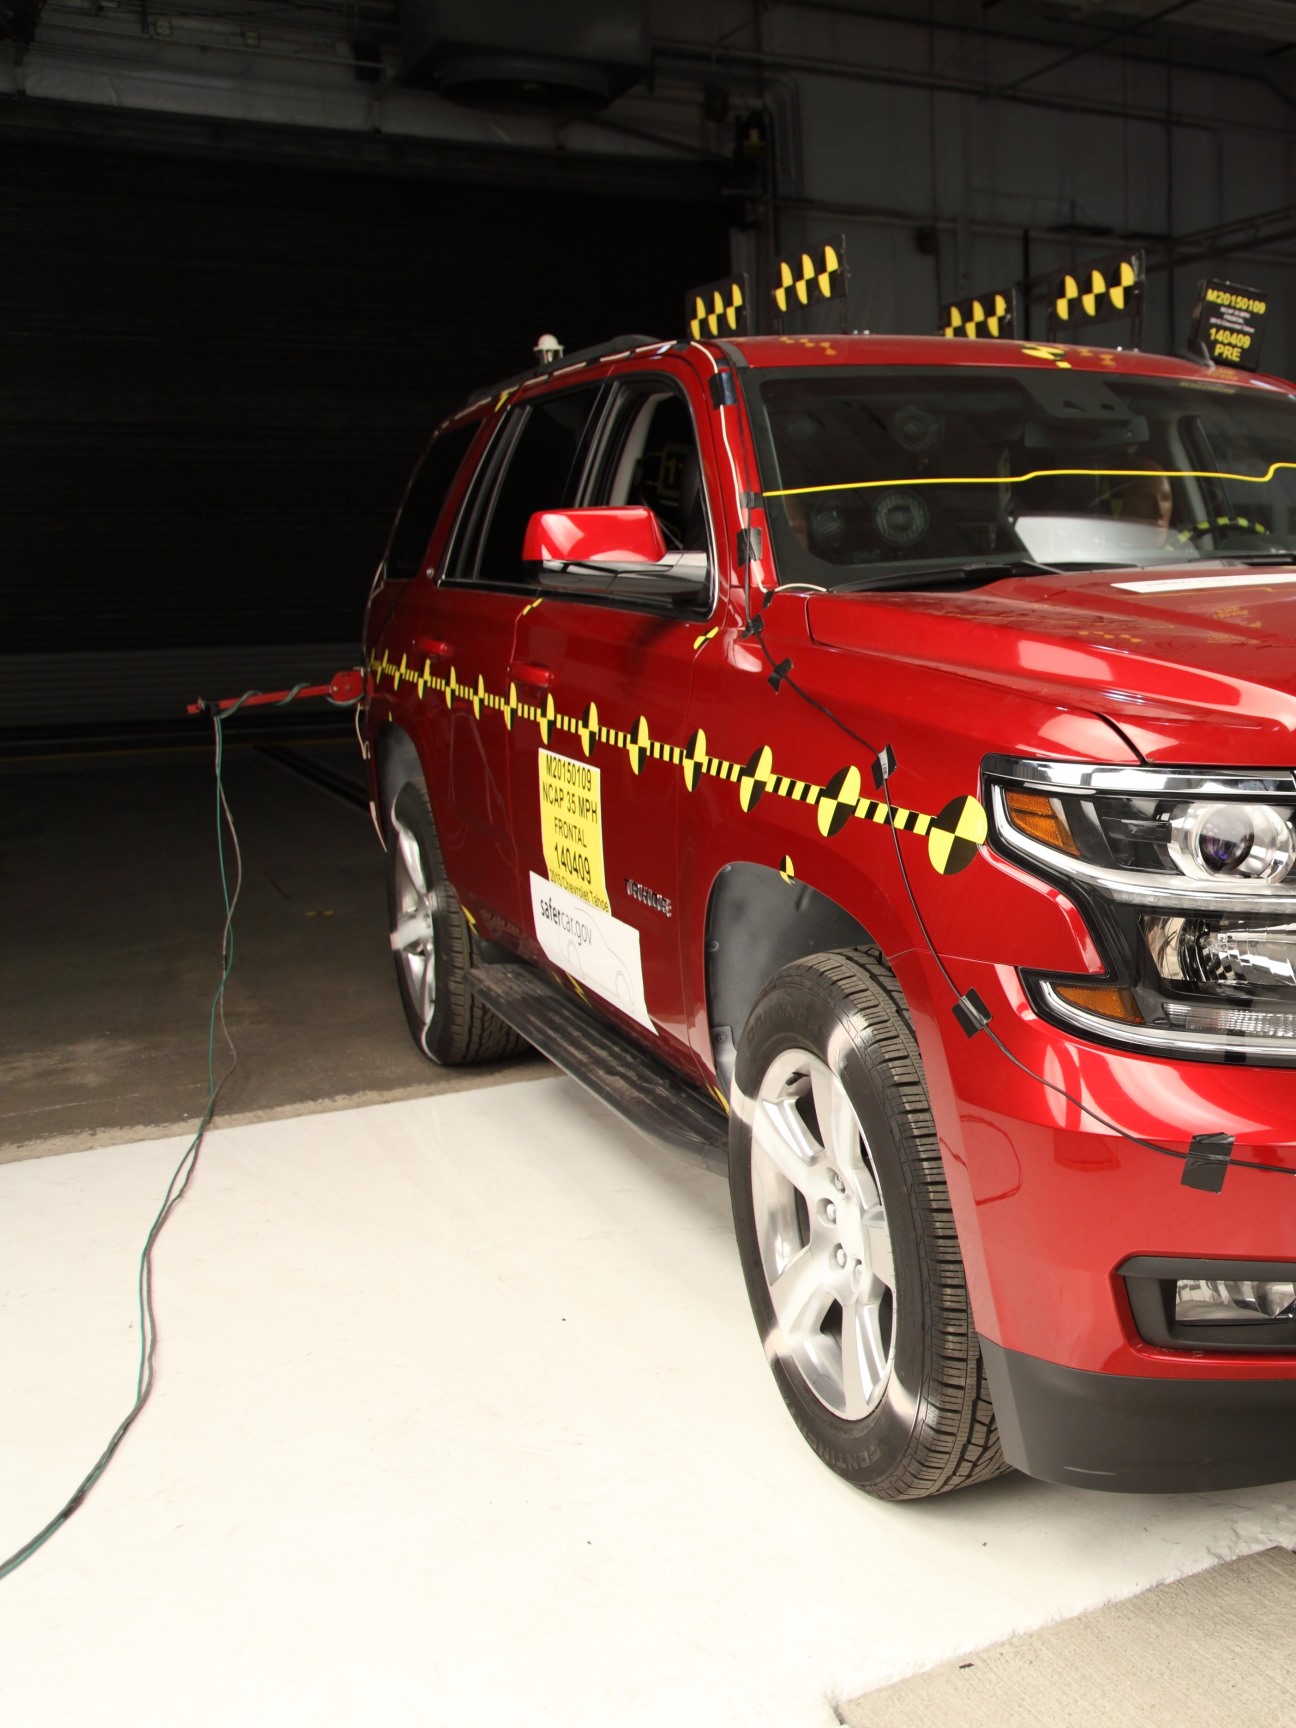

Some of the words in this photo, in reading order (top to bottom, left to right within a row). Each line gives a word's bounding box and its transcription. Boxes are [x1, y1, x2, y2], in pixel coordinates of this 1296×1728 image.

[1206, 288, 1266, 314] M20150109
[1209, 327, 1251, 349] 140409
[1214, 343, 1242, 361] PRE
[546, 754, 592, 791] M20150109
[542, 782, 564, 808] NCAP
[566, 792, 577, 814] 35
[577, 798, 598, 824] MPH
[554, 816, 587, 848] FRONTAL
[554, 845, 592, 885] 140409
[589, 890, 609, 912] Tahoe
[624, 877, 672, 917] TAHOE
[540, 899, 593, 945] safercar.gov
